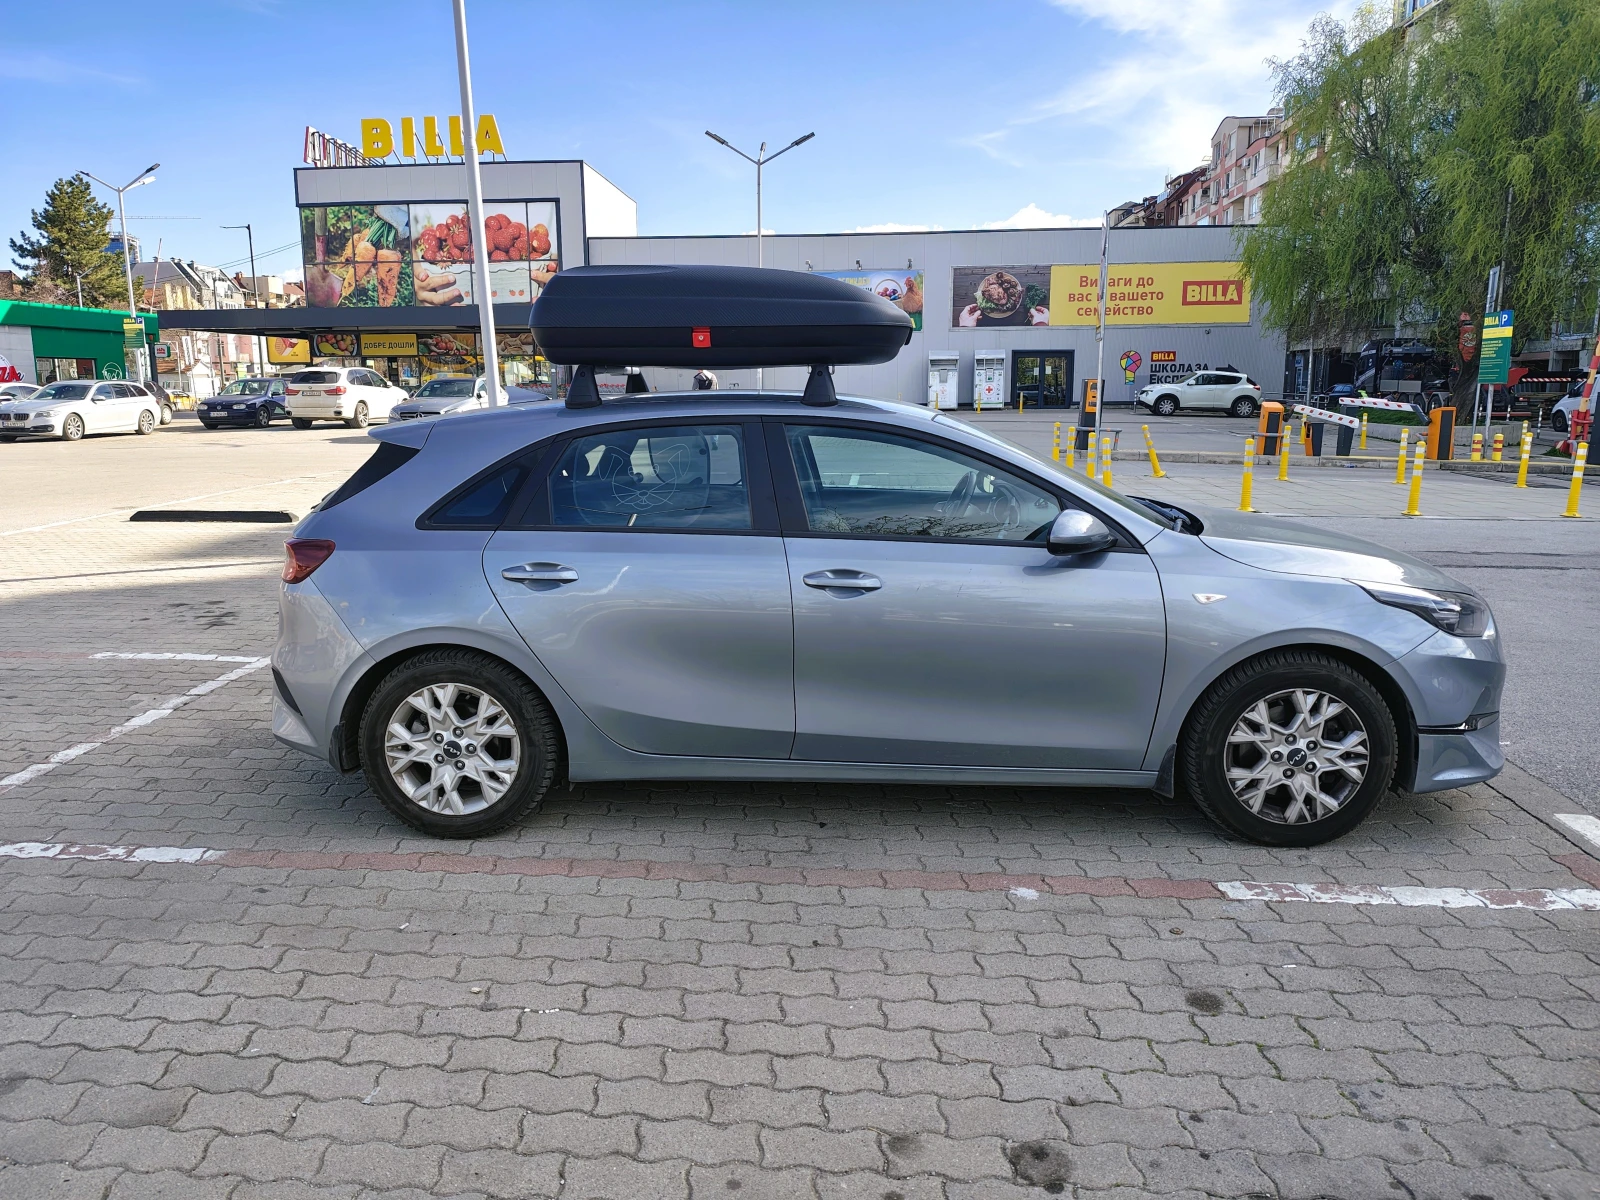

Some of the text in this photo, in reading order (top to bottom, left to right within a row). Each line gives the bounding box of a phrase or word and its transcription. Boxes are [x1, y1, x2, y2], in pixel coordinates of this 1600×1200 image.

[361, 114, 504, 158] BILLA
[1080, 276, 1154, 288] Виаги до
[1068, 293, 1092, 302] вас
[1110, 291, 1164, 301] вашето
[1187, 285, 1238, 301] BILLA
[1502, 314, 1508, 325] P
[364, 342, 386, 350] ДОБРЕ
[1152, 352, 1175, 360] BILLA
[1150, 363, 1193, 373] ШКОЛА
[1149, 374, 1186, 384] ЕКСП
